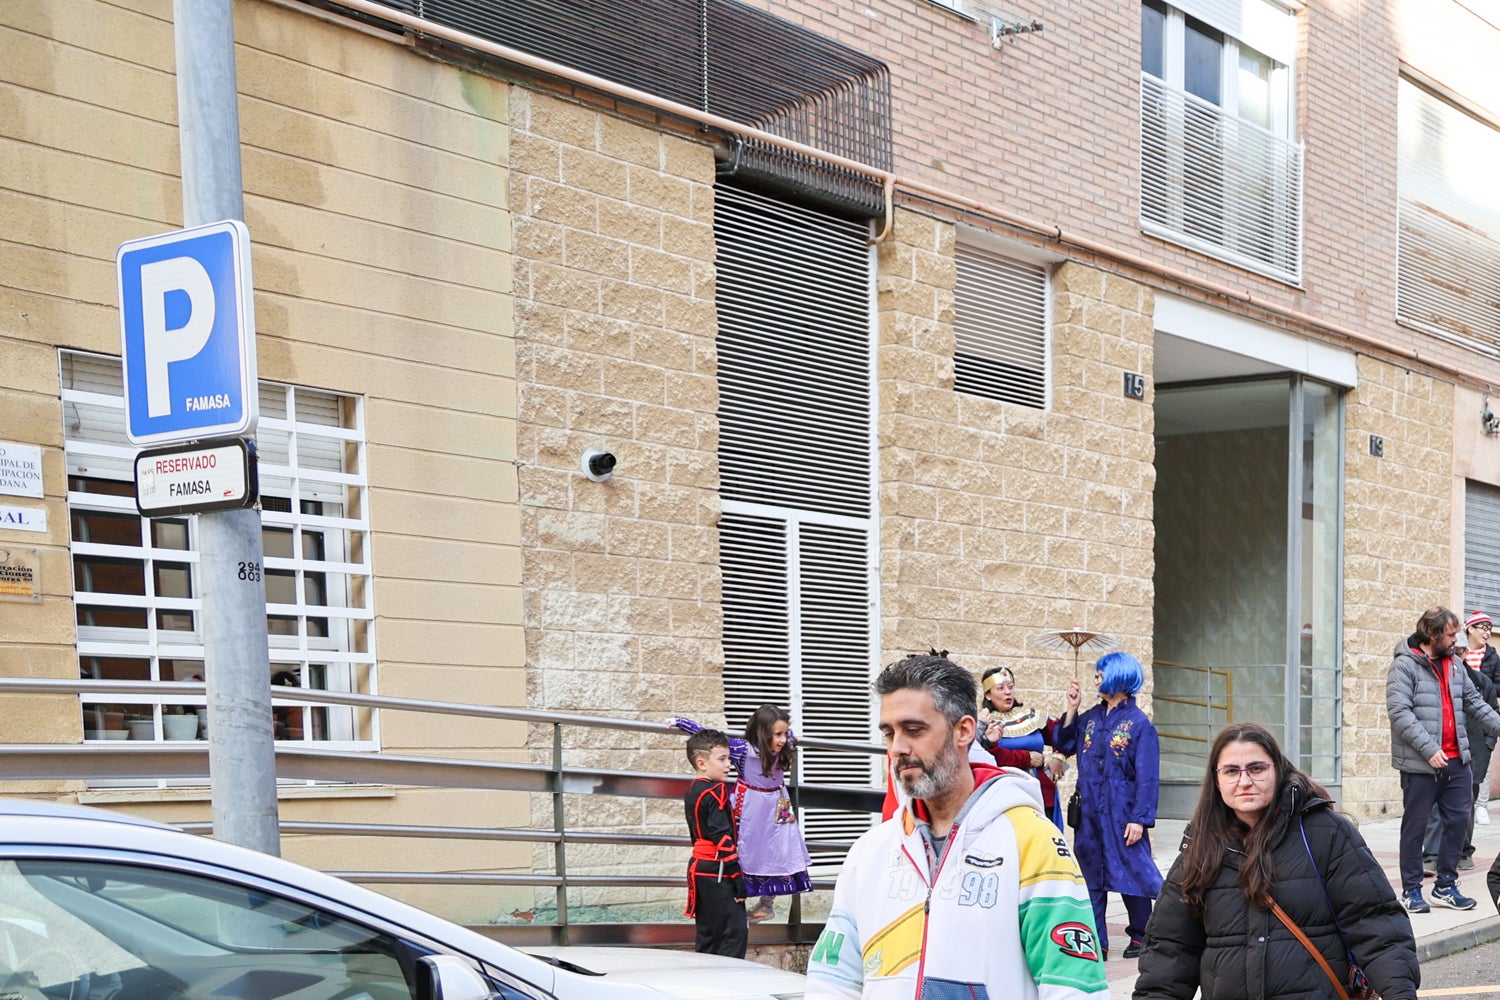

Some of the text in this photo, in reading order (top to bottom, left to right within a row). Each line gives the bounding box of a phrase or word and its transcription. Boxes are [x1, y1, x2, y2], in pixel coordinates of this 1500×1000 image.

[140, 255, 216, 419] P
[1126, 374, 1145, 397] 15
[185, 393, 231, 412] FAMASA
[23, 461, 36, 470] DE
[155, 454, 217, 475] RESERVADO
[0, 468, 40, 480] IPACIÓN
[169, 479, 212, 497] FAMASA
[238, 561, 260, 572] 294
[238, 571, 260, 582] 003
[958, 871, 1000, 909] 98
